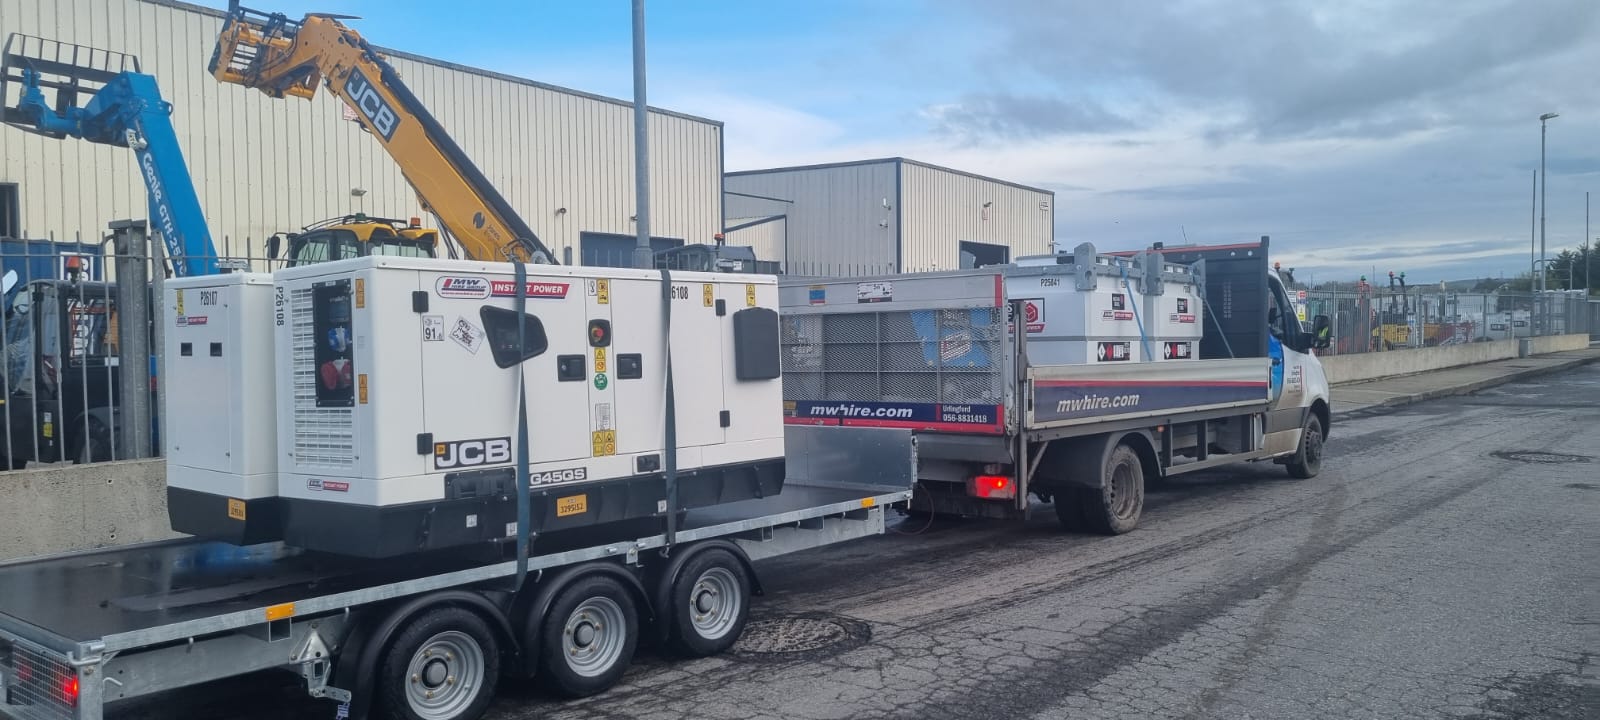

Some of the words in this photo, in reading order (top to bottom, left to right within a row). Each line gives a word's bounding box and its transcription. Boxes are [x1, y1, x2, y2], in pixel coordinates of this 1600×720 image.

[347, 80, 395, 137] JCB
[143, 152, 162, 203] Genie
[494, 284, 531, 293] INSTT
[533, 285, 563, 294] POWER
[671, 286, 689, 300] 6108
[275, 286, 285, 327] P26108
[425, 327, 436, 340] 91
[810, 404, 913, 418] mwhire.com
[942, 405, 971, 414] Urlingford
[1056, 394, 1140, 413] mwhire.com
[943, 413, 988, 424] 056-8831418
[436, 439, 511, 468] JCB
[530, 468, 586, 486] G45QS
